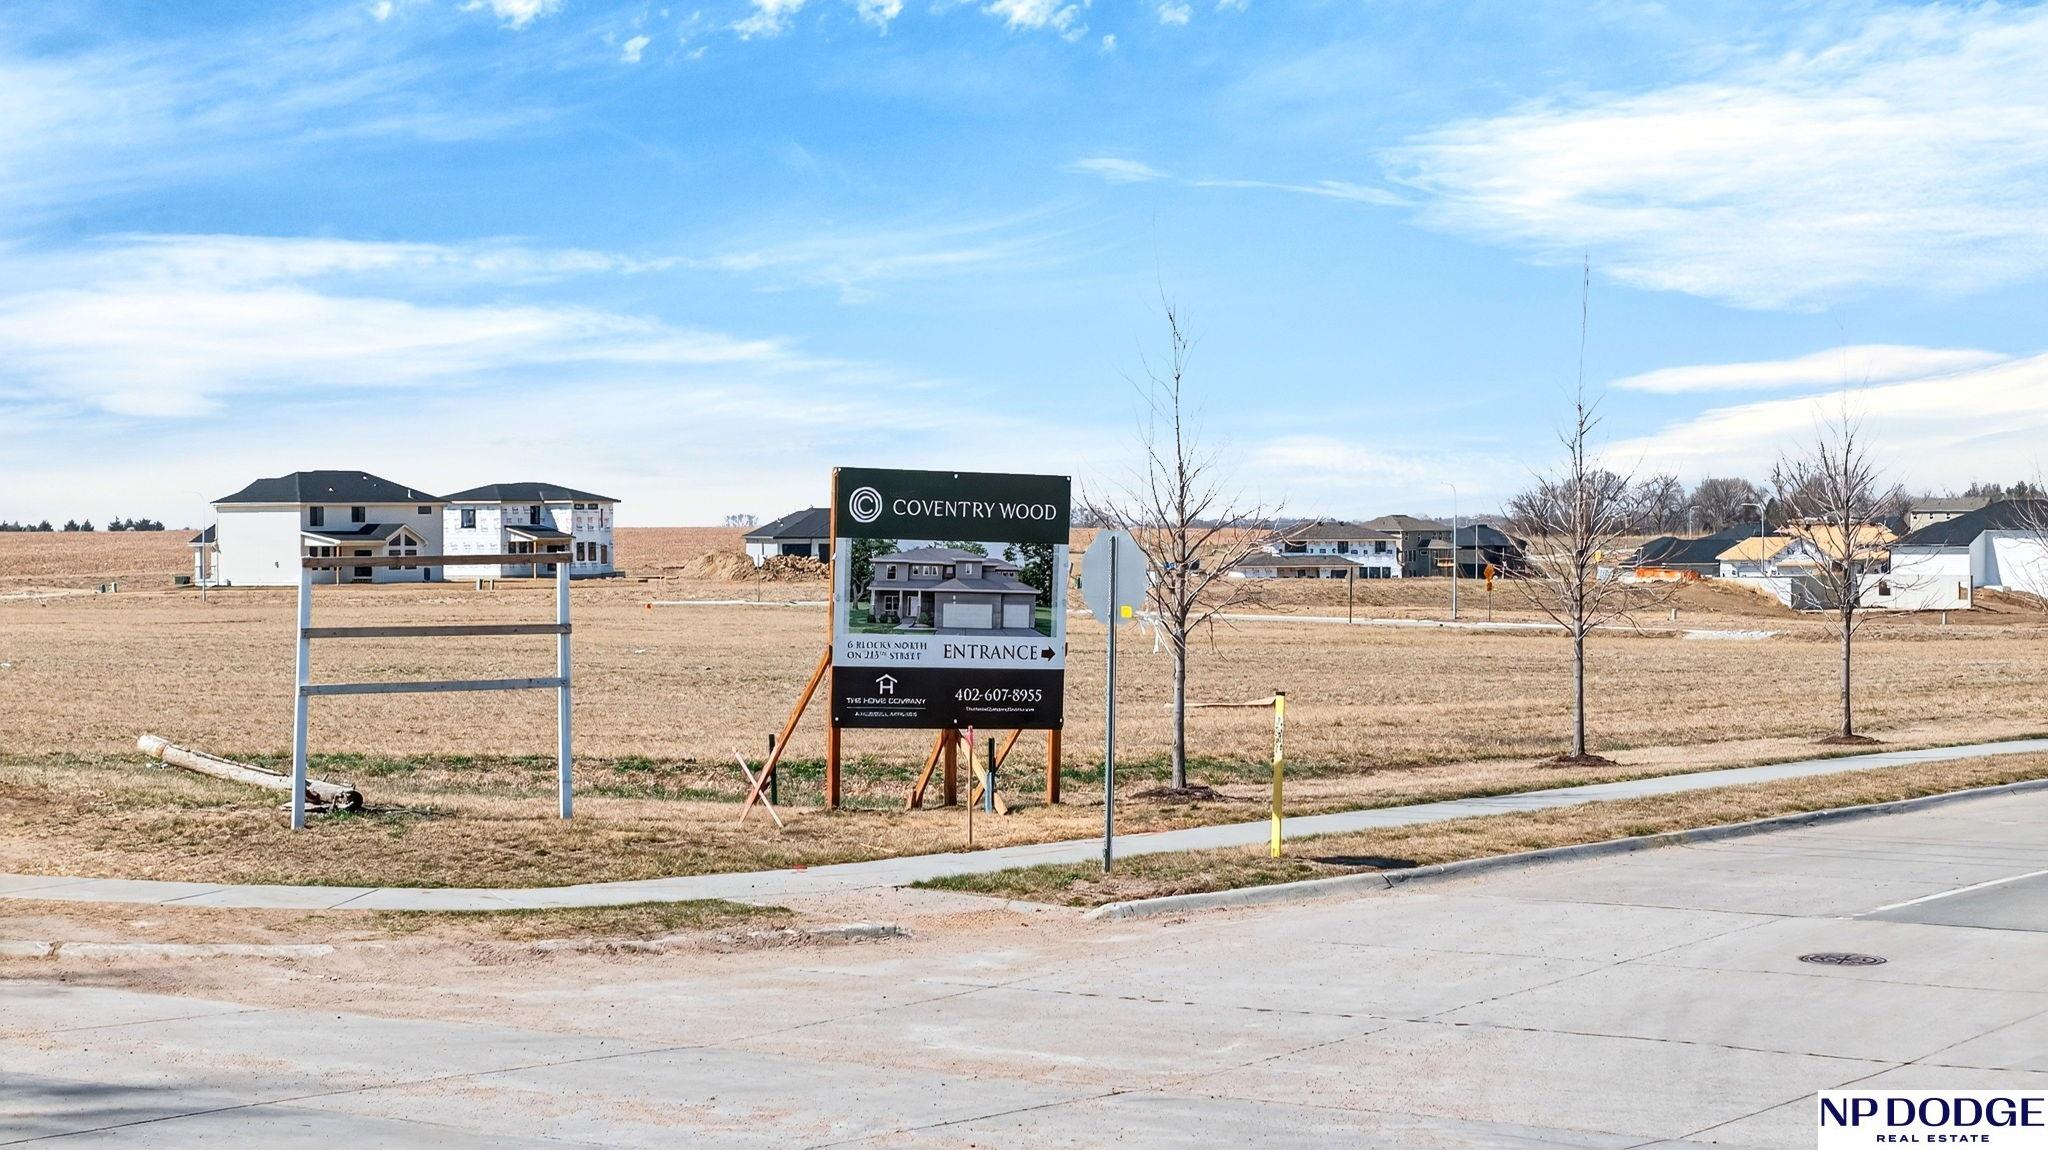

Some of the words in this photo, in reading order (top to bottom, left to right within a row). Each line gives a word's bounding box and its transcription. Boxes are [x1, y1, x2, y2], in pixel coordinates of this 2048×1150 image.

[893, 498, 996, 519] COVENTRY
[998, 502, 1057, 521] WOOD
[847, 640, 854, 649] 6
[894, 641, 927, 650] NORTH
[847, 651, 862, 659] ON
[889, 652, 922, 660] STREET
[943, 643, 1038, 661] ENTRANCE
[954, 687, 1043, 702] 402-607-8955
[863, 697, 887, 705] HOME
[888, 697, 926, 705] COMPANY
